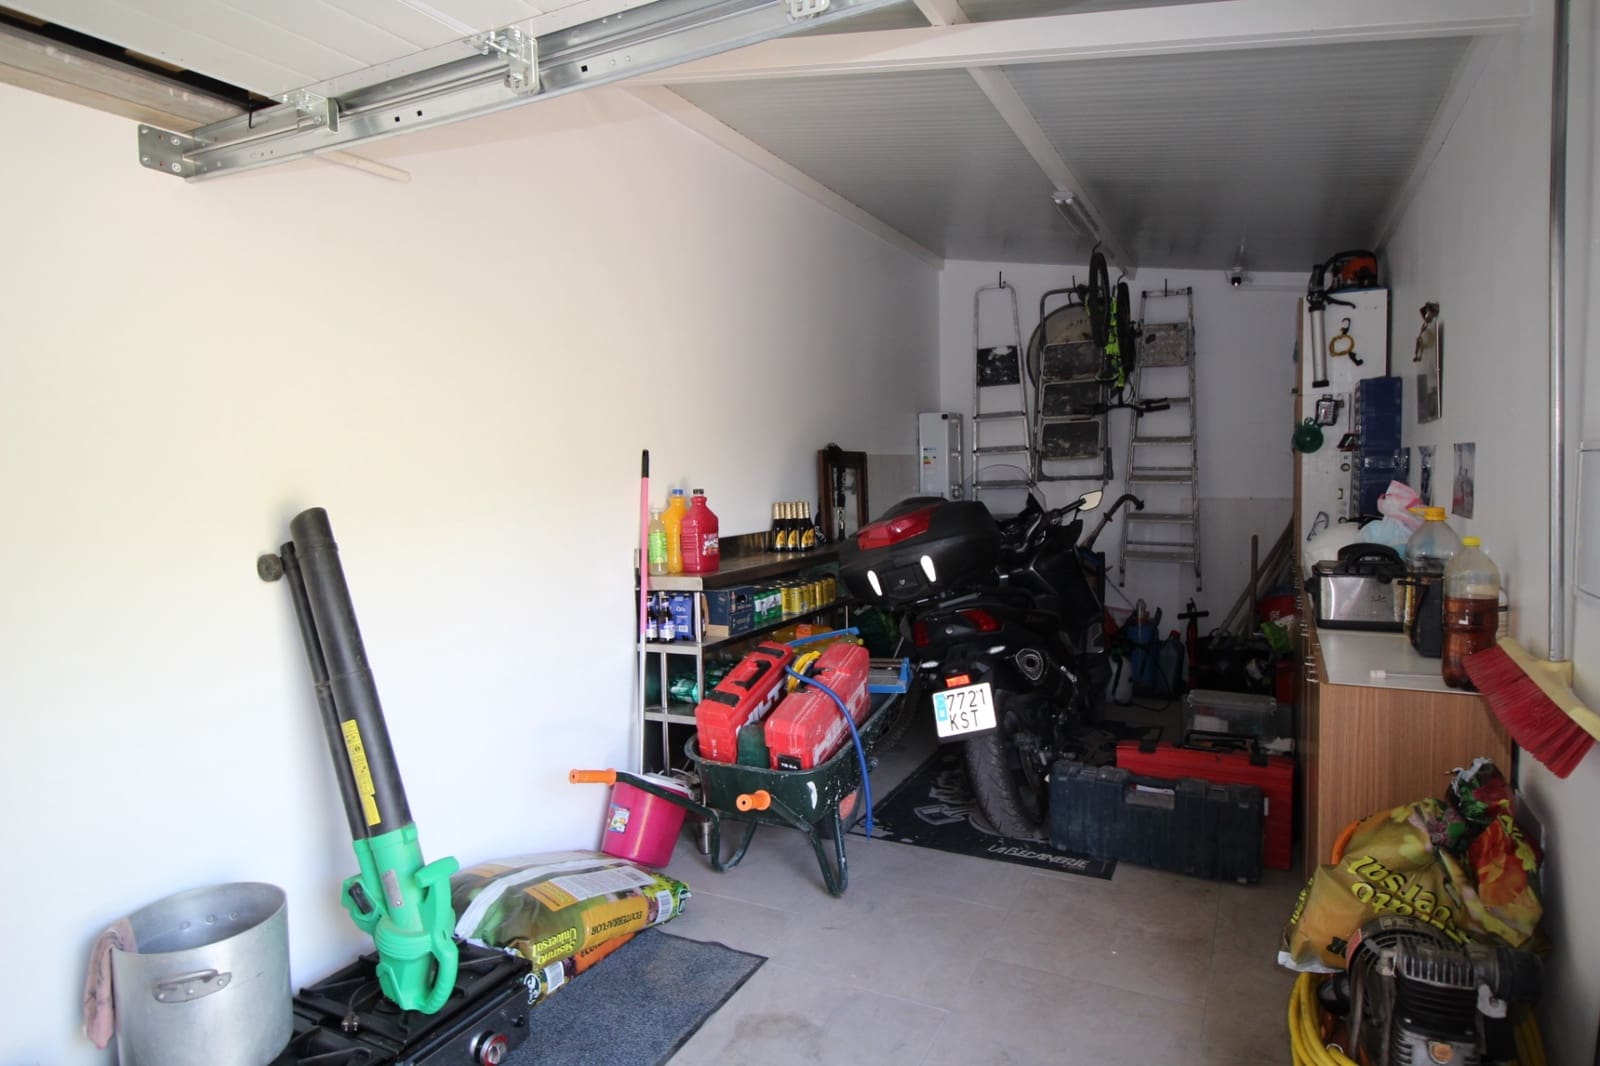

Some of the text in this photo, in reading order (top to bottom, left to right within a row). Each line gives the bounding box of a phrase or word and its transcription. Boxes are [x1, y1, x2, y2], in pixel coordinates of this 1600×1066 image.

[946, 688, 986, 712] 7721
[949, 709, 979, 731] KST
[531, 926, 578, 957] Universal
